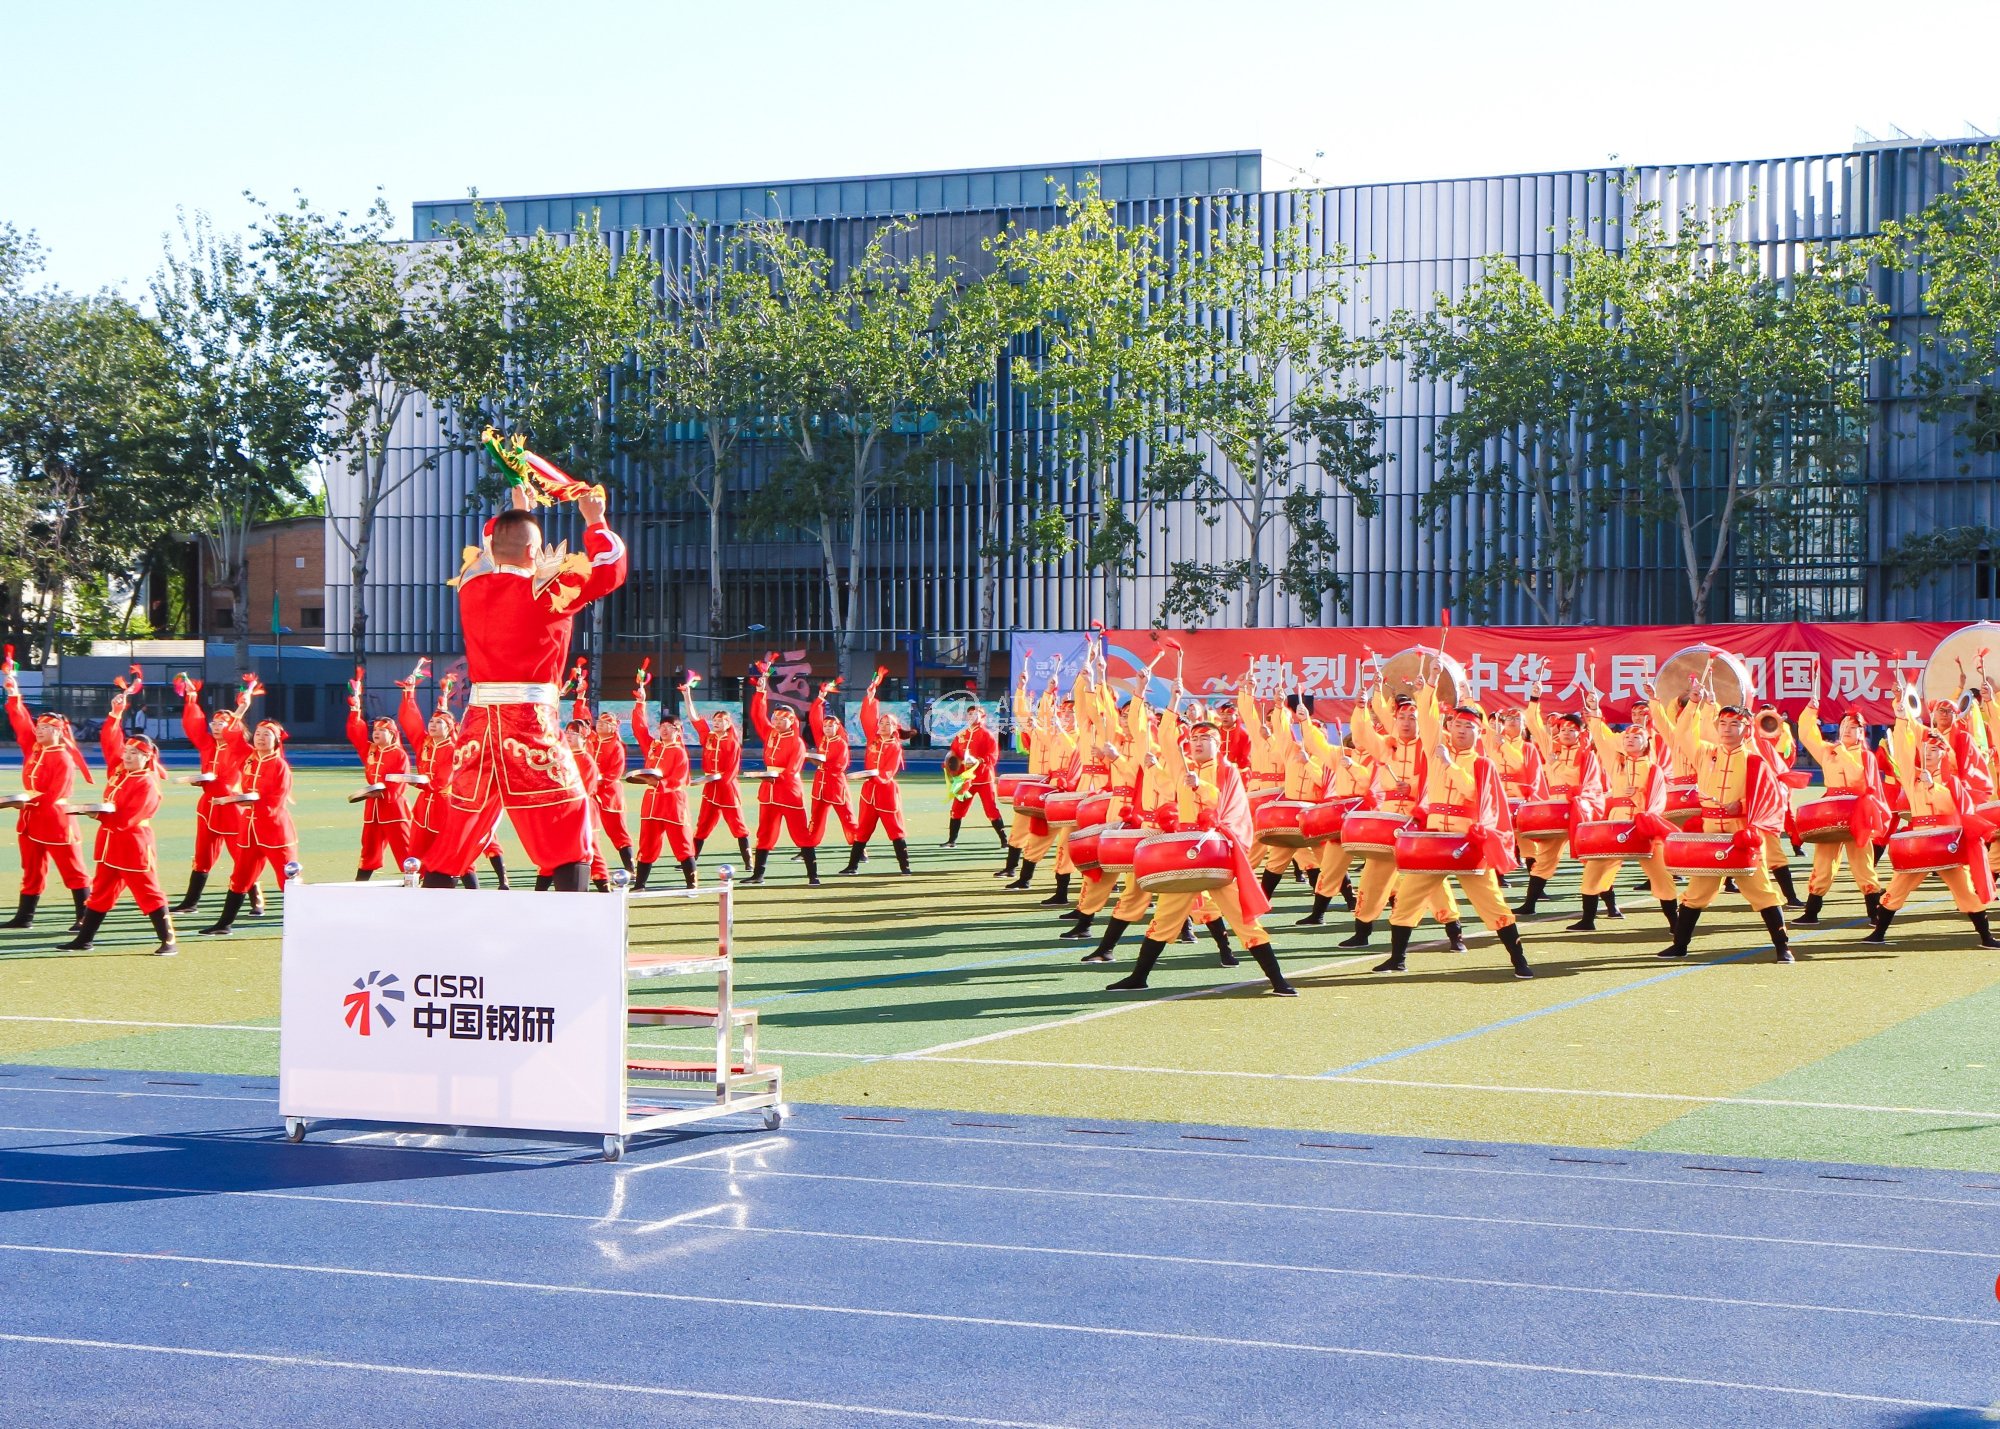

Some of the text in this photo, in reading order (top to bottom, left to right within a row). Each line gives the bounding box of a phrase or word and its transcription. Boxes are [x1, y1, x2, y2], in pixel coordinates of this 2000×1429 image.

[1252, 651, 1928, 702] 热烈庆中华人民国成立
[413, 974, 484, 999] CISRI
[413, 1002, 555, 1043] 中国钢研
